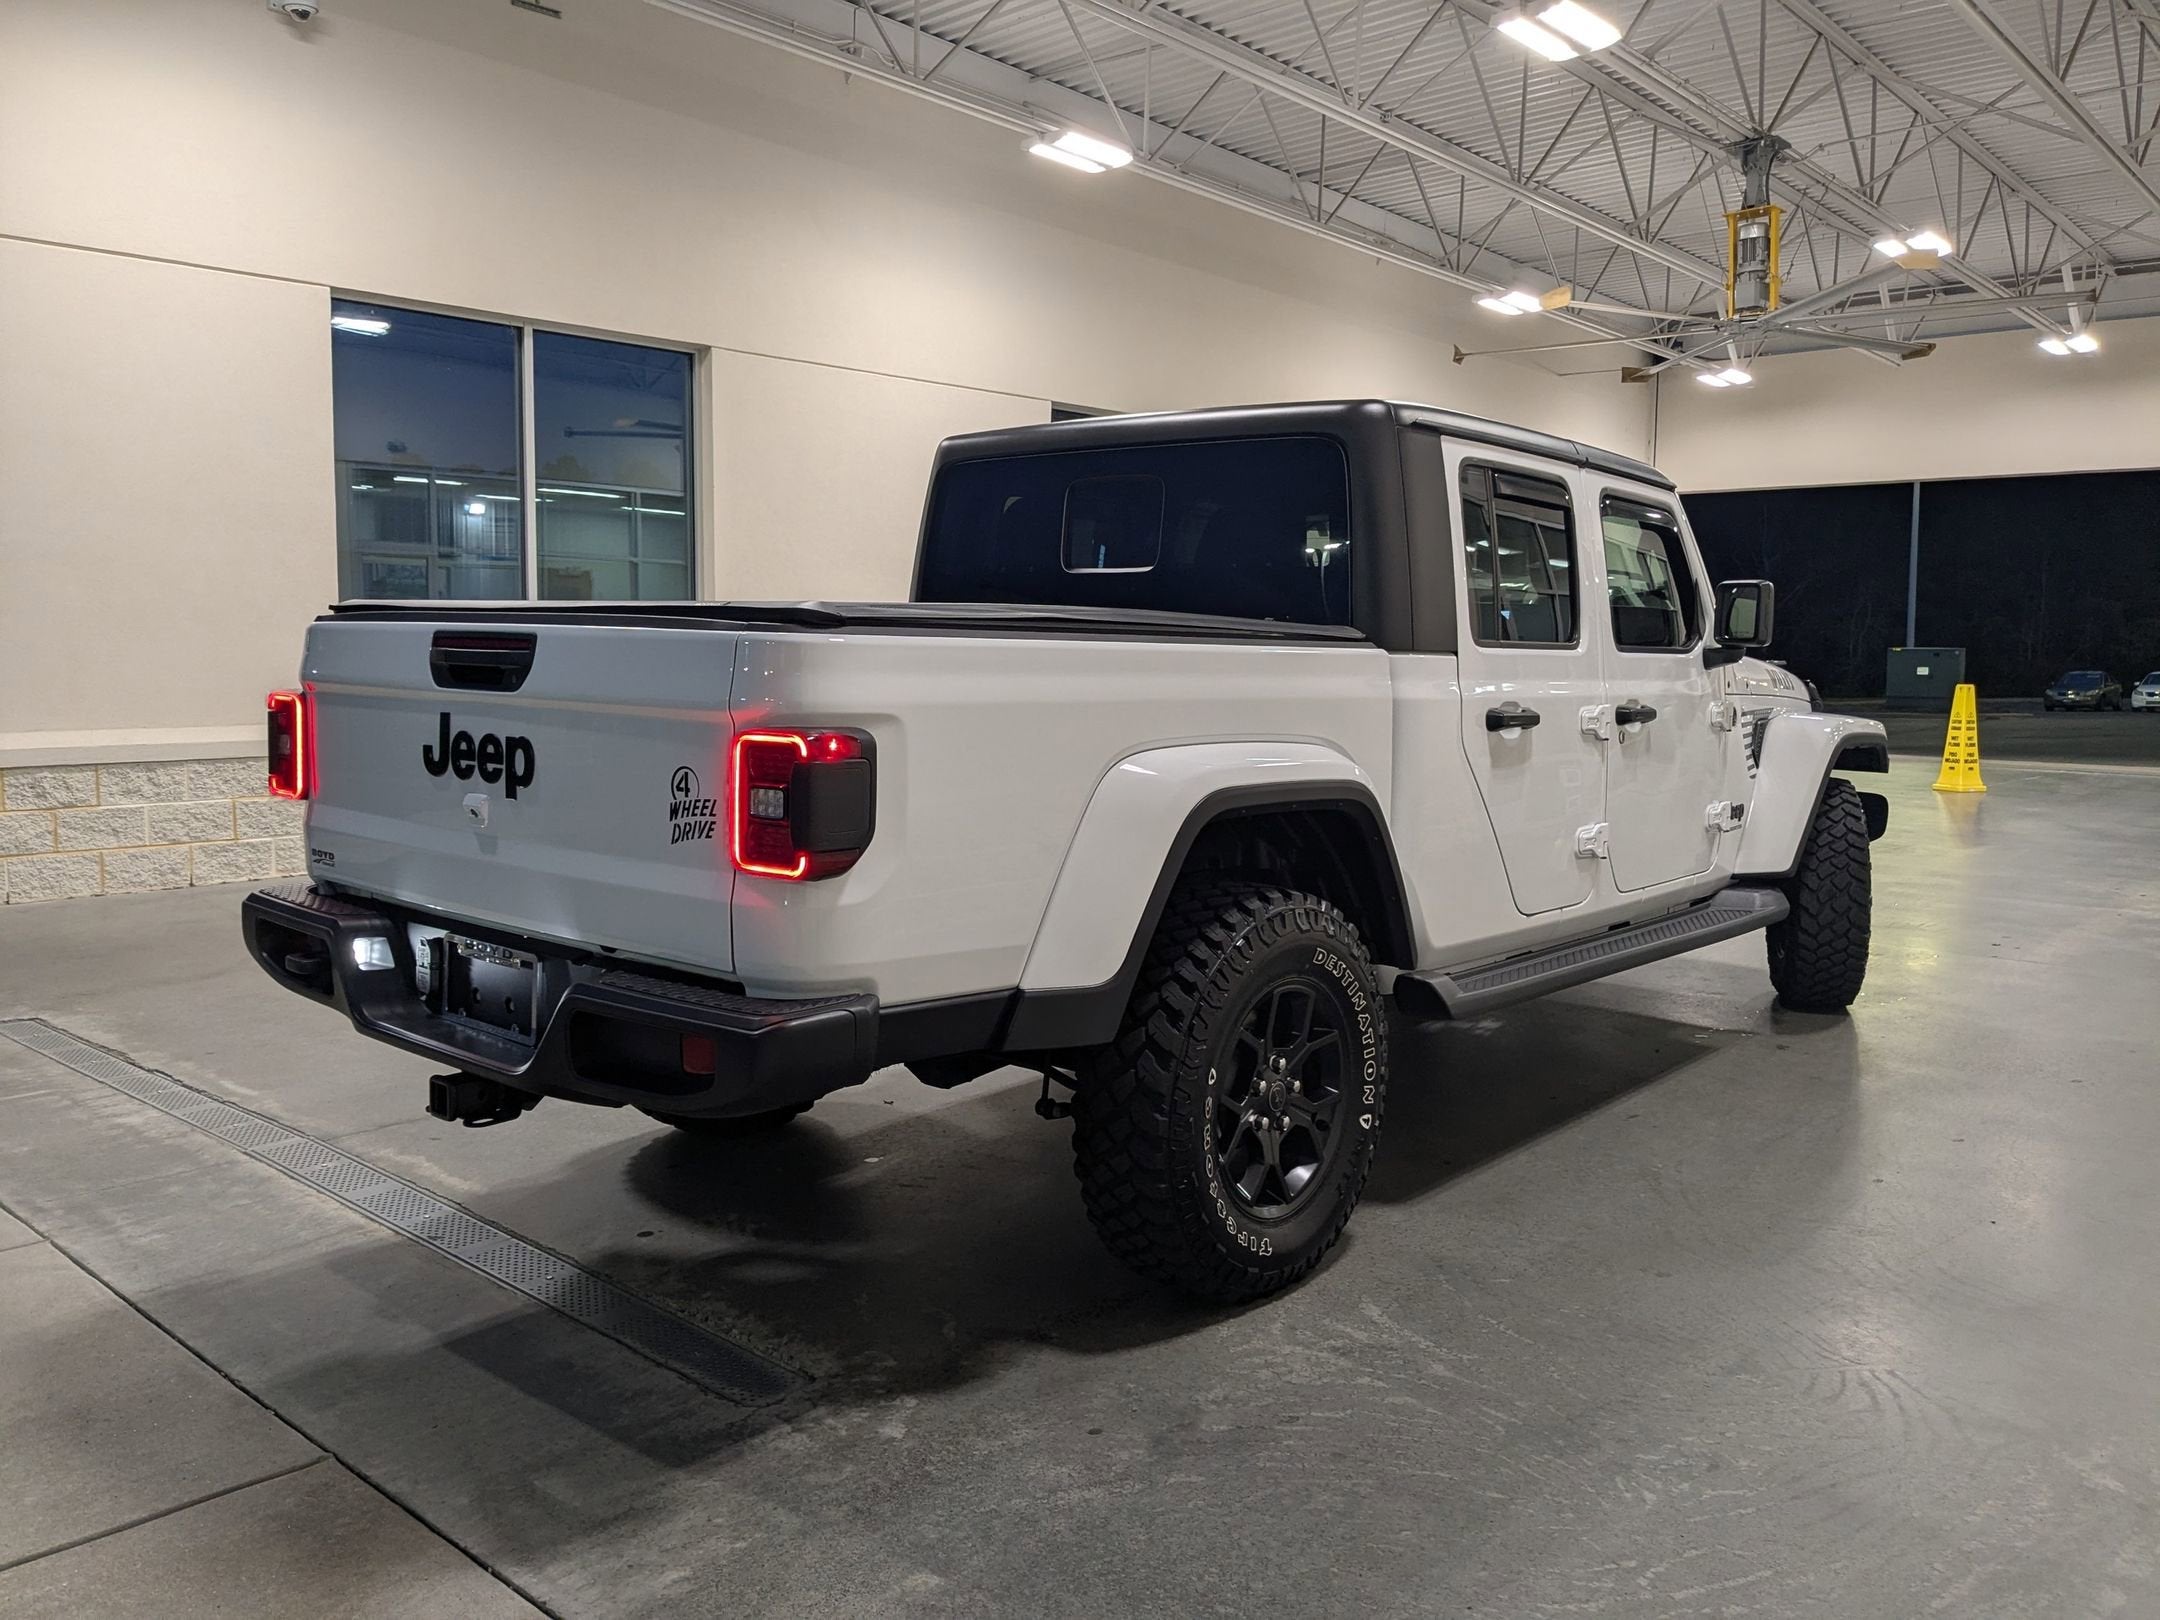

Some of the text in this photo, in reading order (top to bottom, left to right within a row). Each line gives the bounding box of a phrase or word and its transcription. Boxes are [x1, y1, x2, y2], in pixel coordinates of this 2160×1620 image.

[422, 712, 535, 800] Jeep
[675, 771, 690, 798] 4
[669, 799, 717, 822] WHEEL
[671, 820, 716, 845] DRIVE
[1312, 947, 1377, 1104] DESTINATION
